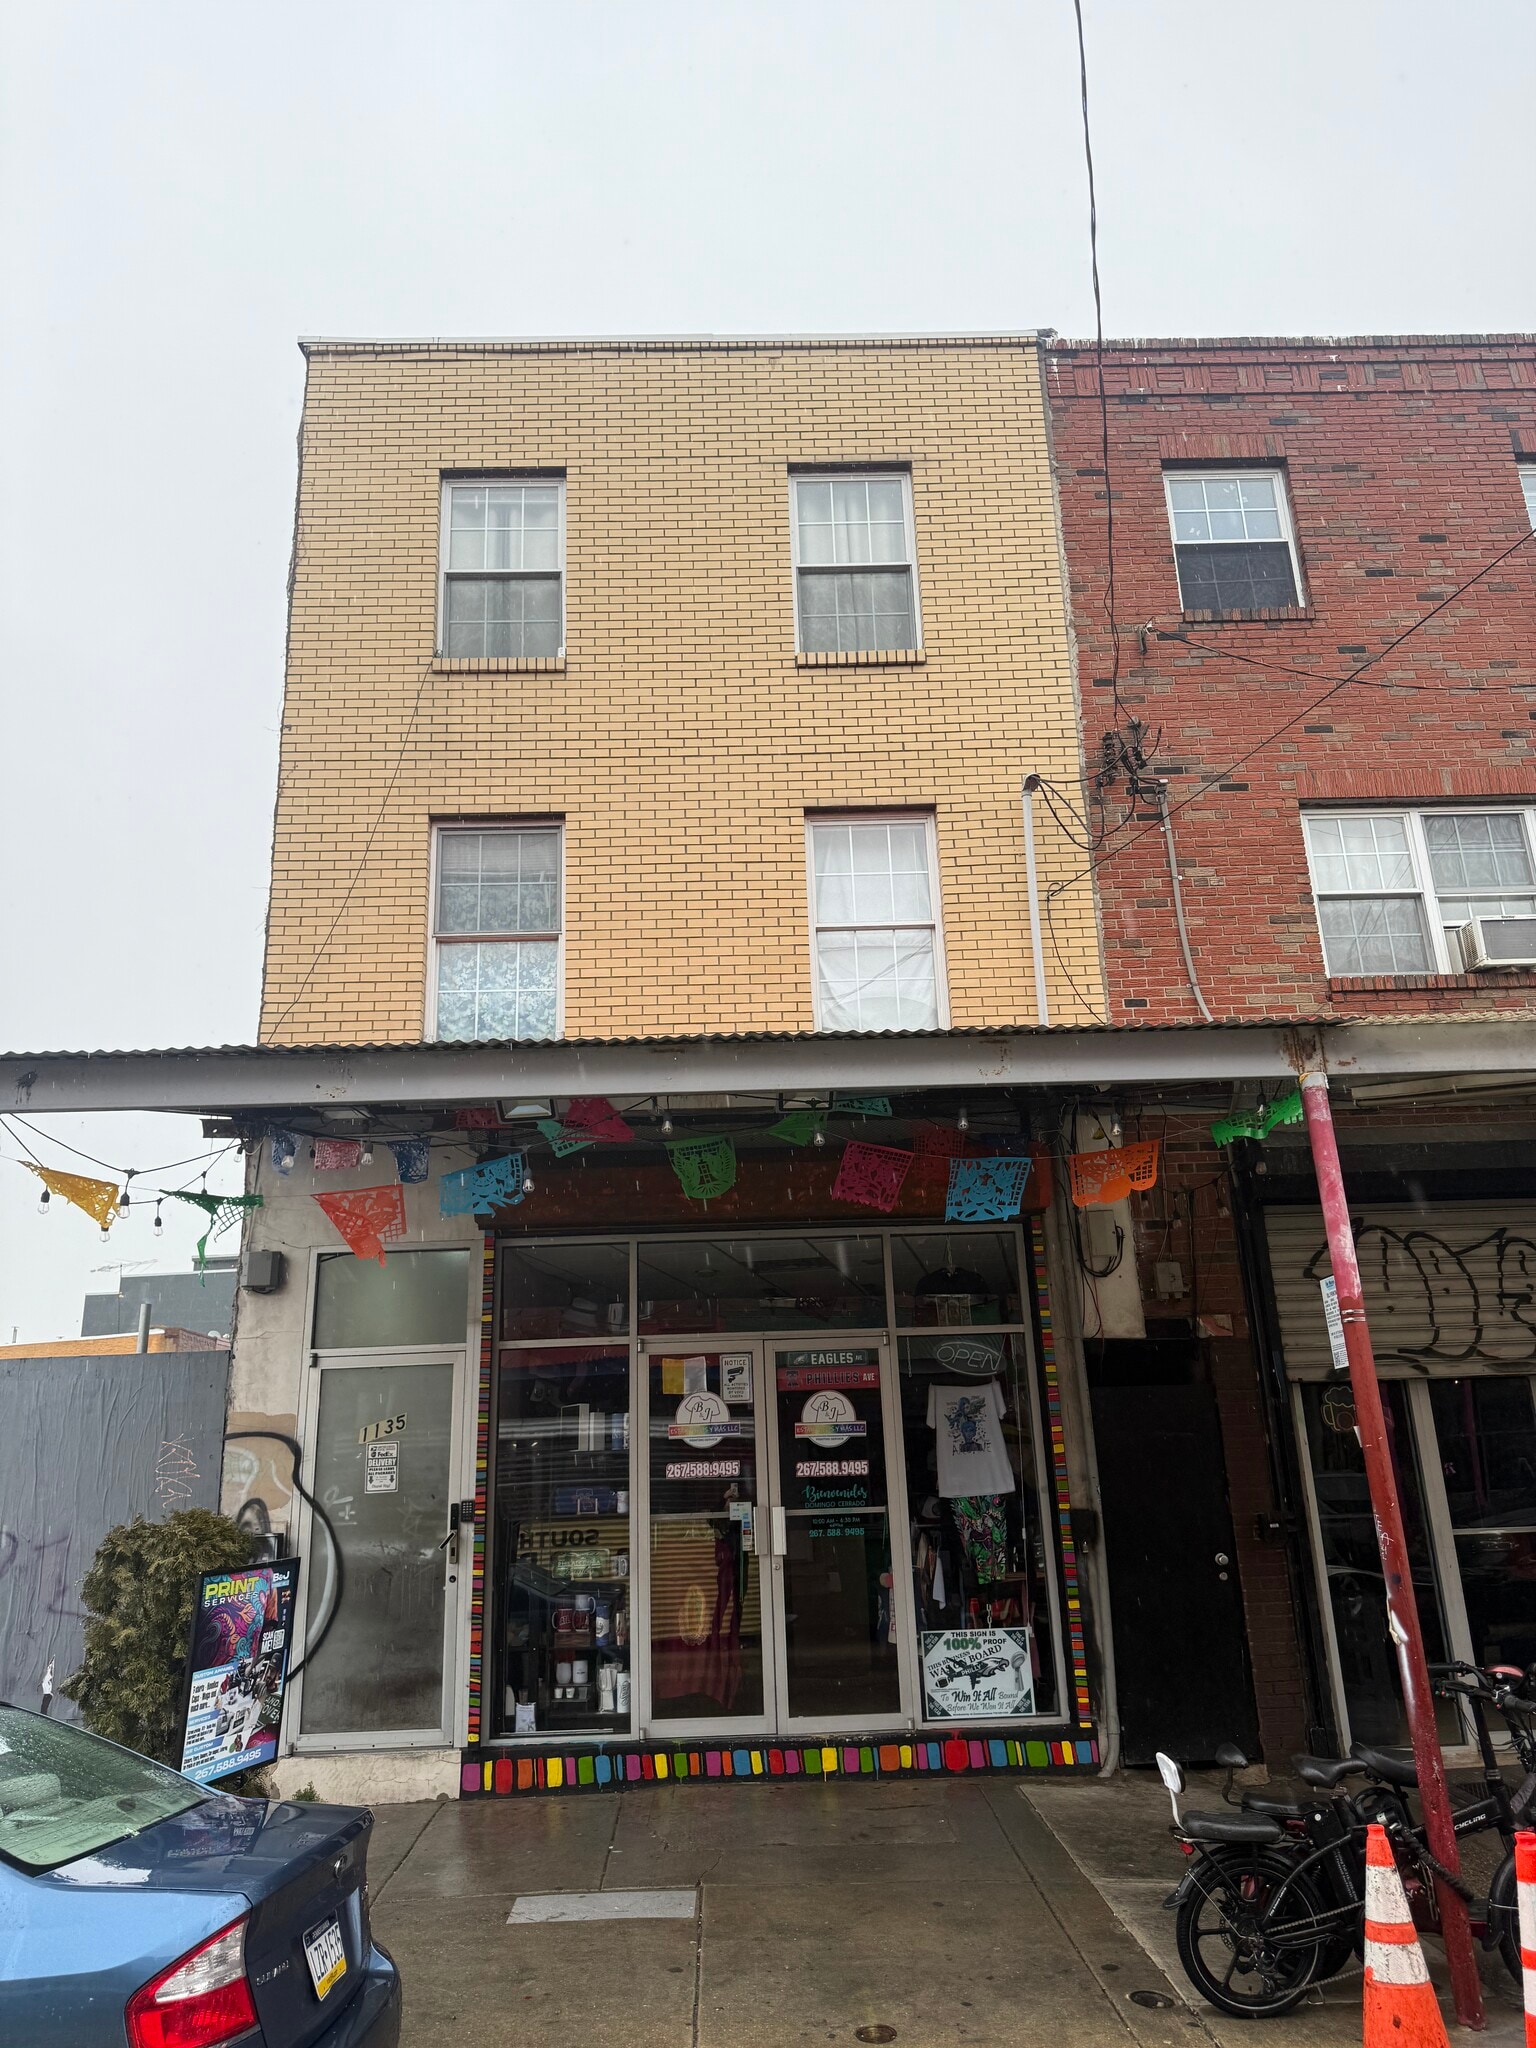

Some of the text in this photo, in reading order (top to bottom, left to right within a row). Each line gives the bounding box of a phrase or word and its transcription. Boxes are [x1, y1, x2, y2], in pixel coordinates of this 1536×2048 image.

[811, 1352, 854, 1365] EAGLES
[937, 1346, 1000, 1370] OPEN
[806, 1372, 875, 1385] PHILLIES AVE
[694, 1402, 703, 1412] B
[703, 1408, 710, 1420] J
[820, 1400, 829, 1411] B
[829, 1407, 836, 1419] J
[363, 1414, 406, 1442] 1135
[368, 1458, 397, 1467] DELIVERY
[667, 1461, 740, 1478] 267.588.9495
[796, 1460, 868, 1477] 267.588.9495
[802, 1484, 868, 1502] Bienvenidos
[845, 1527, 865, 1536] 9495
[272, 1571, 290, 1582] B&J
[205, 1576, 260, 1600] PRINT
[204, 1592, 259, 1608] SERVICES
[263, 1630, 274, 1641] SCAN
[261, 1640, 273, 1654] ME!
[944, 1637, 982, 1650] 100%
[928, 1662, 941, 1670] THIS
[929, 1664, 950, 1678] WAS
[968, 1644, 1002, 1663] BOARD
[194, 1666, 234, 1679] CUSTOM APPAREL
[952, 1690, 971, 1702] Win
[973, 1690, 981, 1701] It
[983, 1687, 998, 1701] All
[998, 1690, 1018, 1699] Bound
[946, 1702, 966, 1713] Before
[981, 1702, 996, 1710] Won
[189, 1715, 211, 1724] SERVICES
[194, 1742, 214, 1752] CUSTOM
[194, 1748, 261, 1780] 267.588.9495
